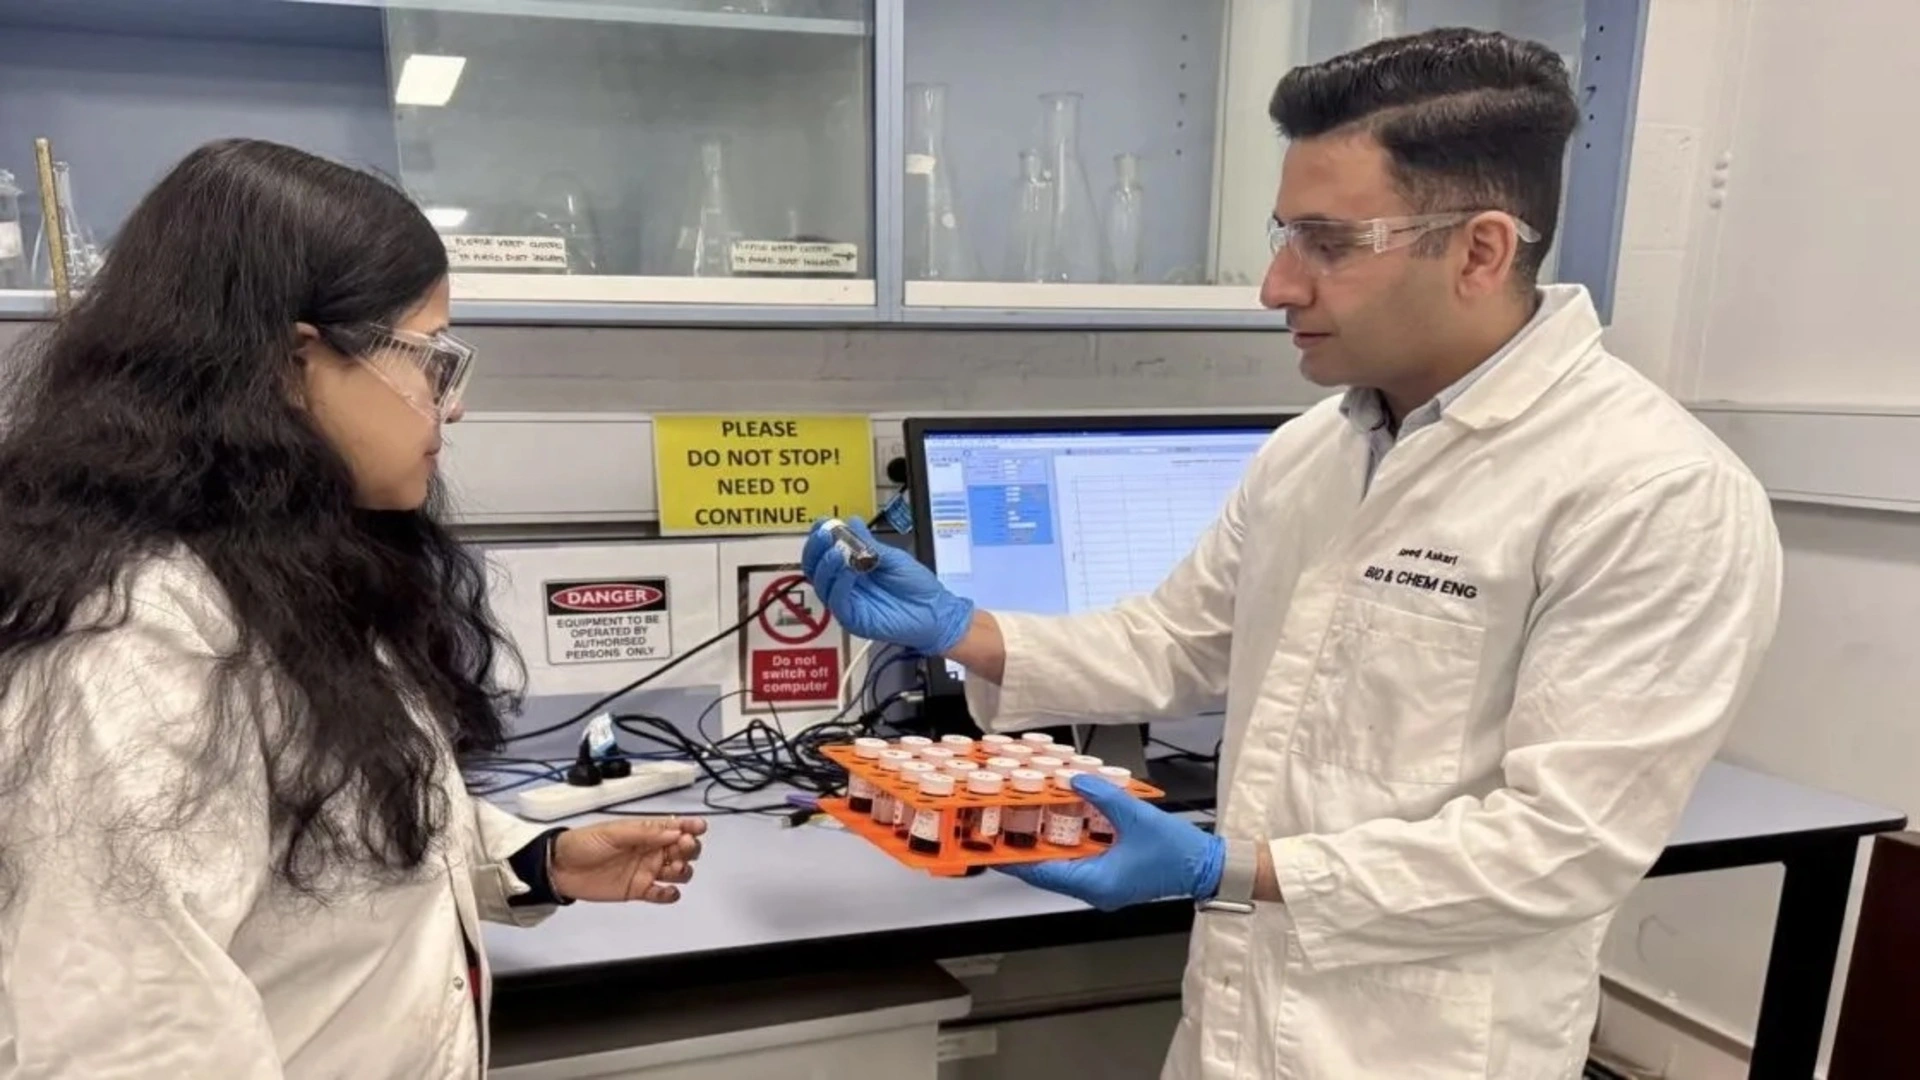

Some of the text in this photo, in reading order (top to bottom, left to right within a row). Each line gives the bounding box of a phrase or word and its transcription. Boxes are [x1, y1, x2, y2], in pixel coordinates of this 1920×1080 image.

[722, 421, 797, 437] PLEASE
[687, 448, 840, 466] DO NOT STOP!
[718, 478, 809, 495] NEED TO
[1425, 549, 1459, 565] Askari
[1384, 569, 1394, 583] &
[1396, 571, 1439, 591] CHEM
[1440, 579, 1478, 599] ENG
[567, 589, 648, 604] DANGER
[557, 614, 659, 628] EQUIPMENT TO BE
[570, 625, 649, 638] OPERATED BY
[573, 636, 646, 648] AUTHORISED
[566, 646, 655, 659] PERSONS ONLY
[772, 655, 817, 666] Do not
[762, 666, 829, 680] switch off
[763, 681, 829, 695] computer
